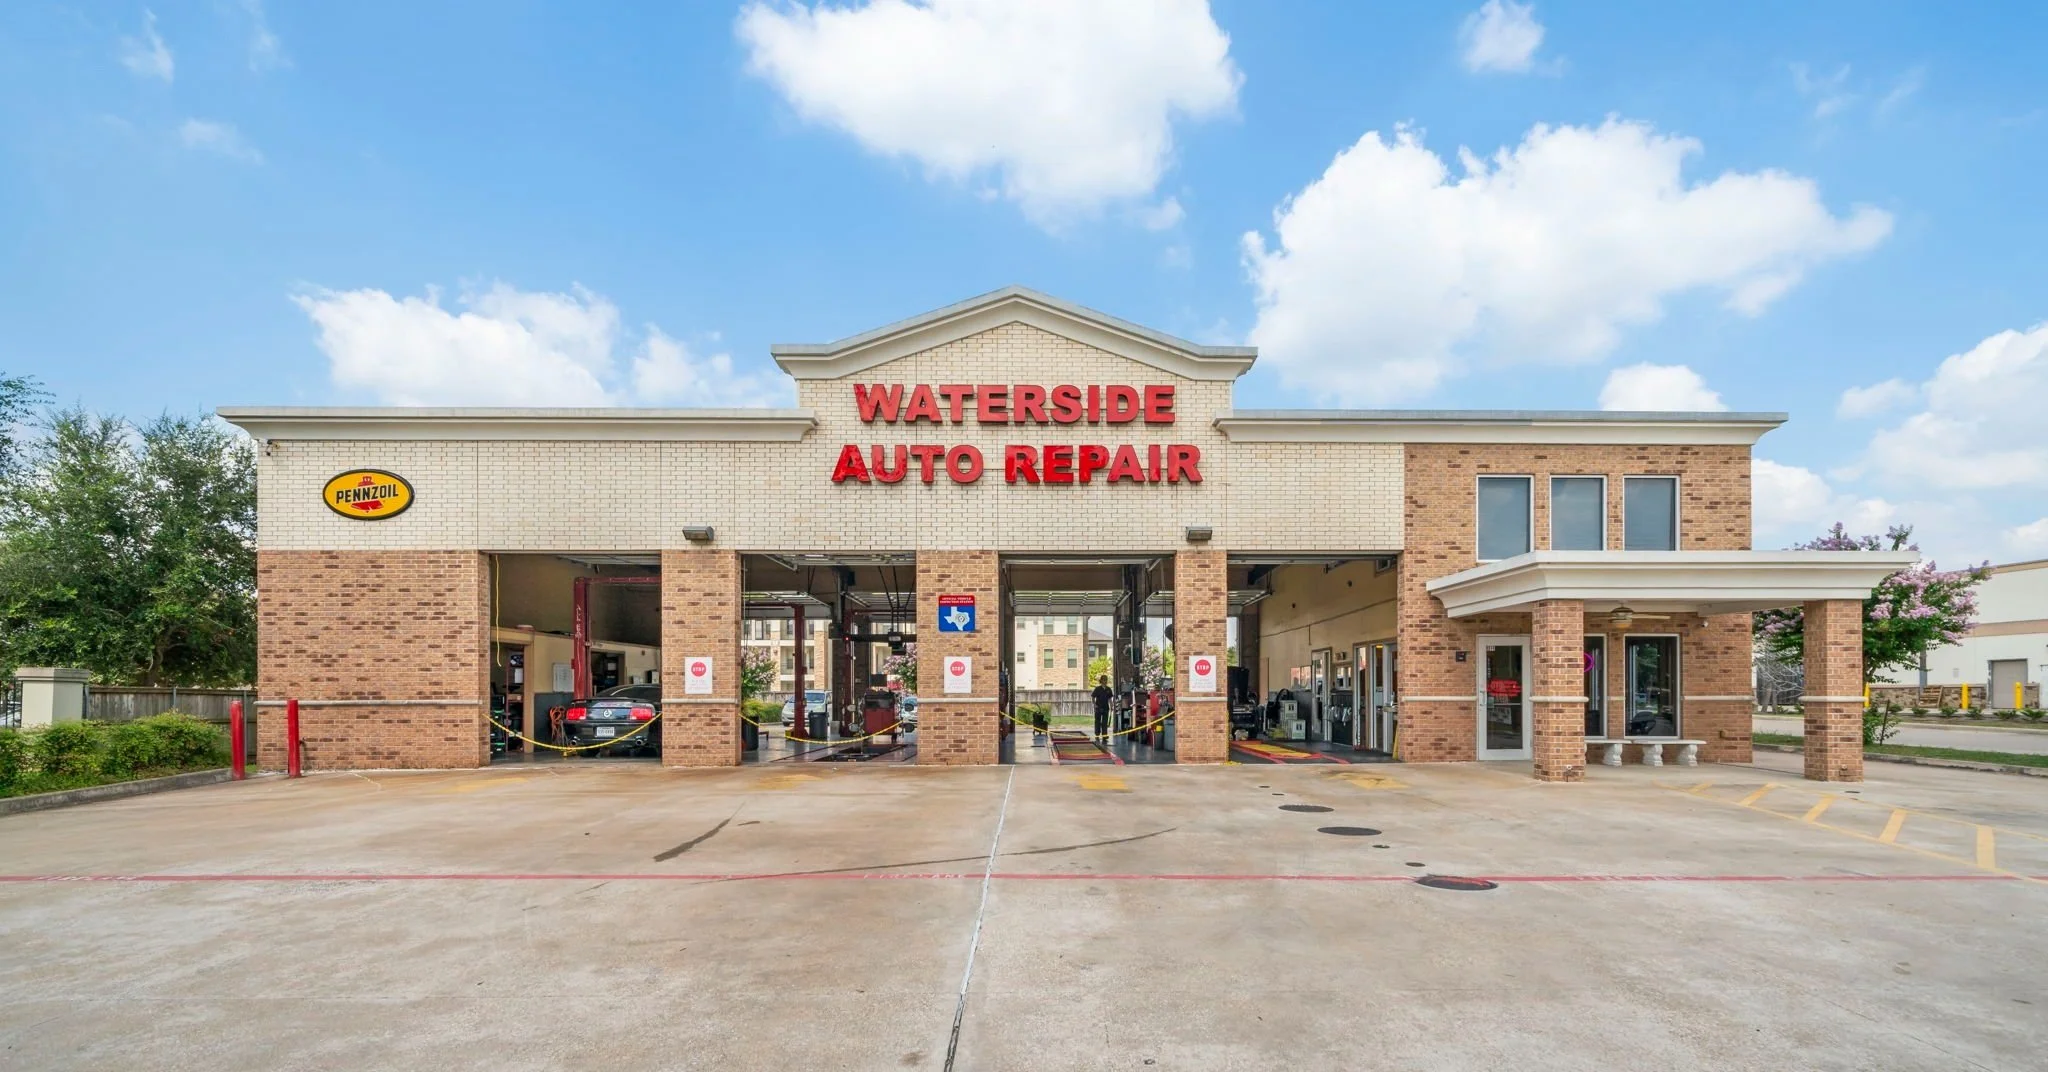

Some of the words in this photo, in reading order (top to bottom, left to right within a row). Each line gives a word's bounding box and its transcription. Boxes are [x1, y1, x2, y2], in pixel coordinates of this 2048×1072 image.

[853, 384, 1176, 424] WATERSIDE
[831, 444, 984, 483] AUTO
[1004, 444, 1204, 483] REPAIR
[335, 484, 399, 504] PENNZOIL
